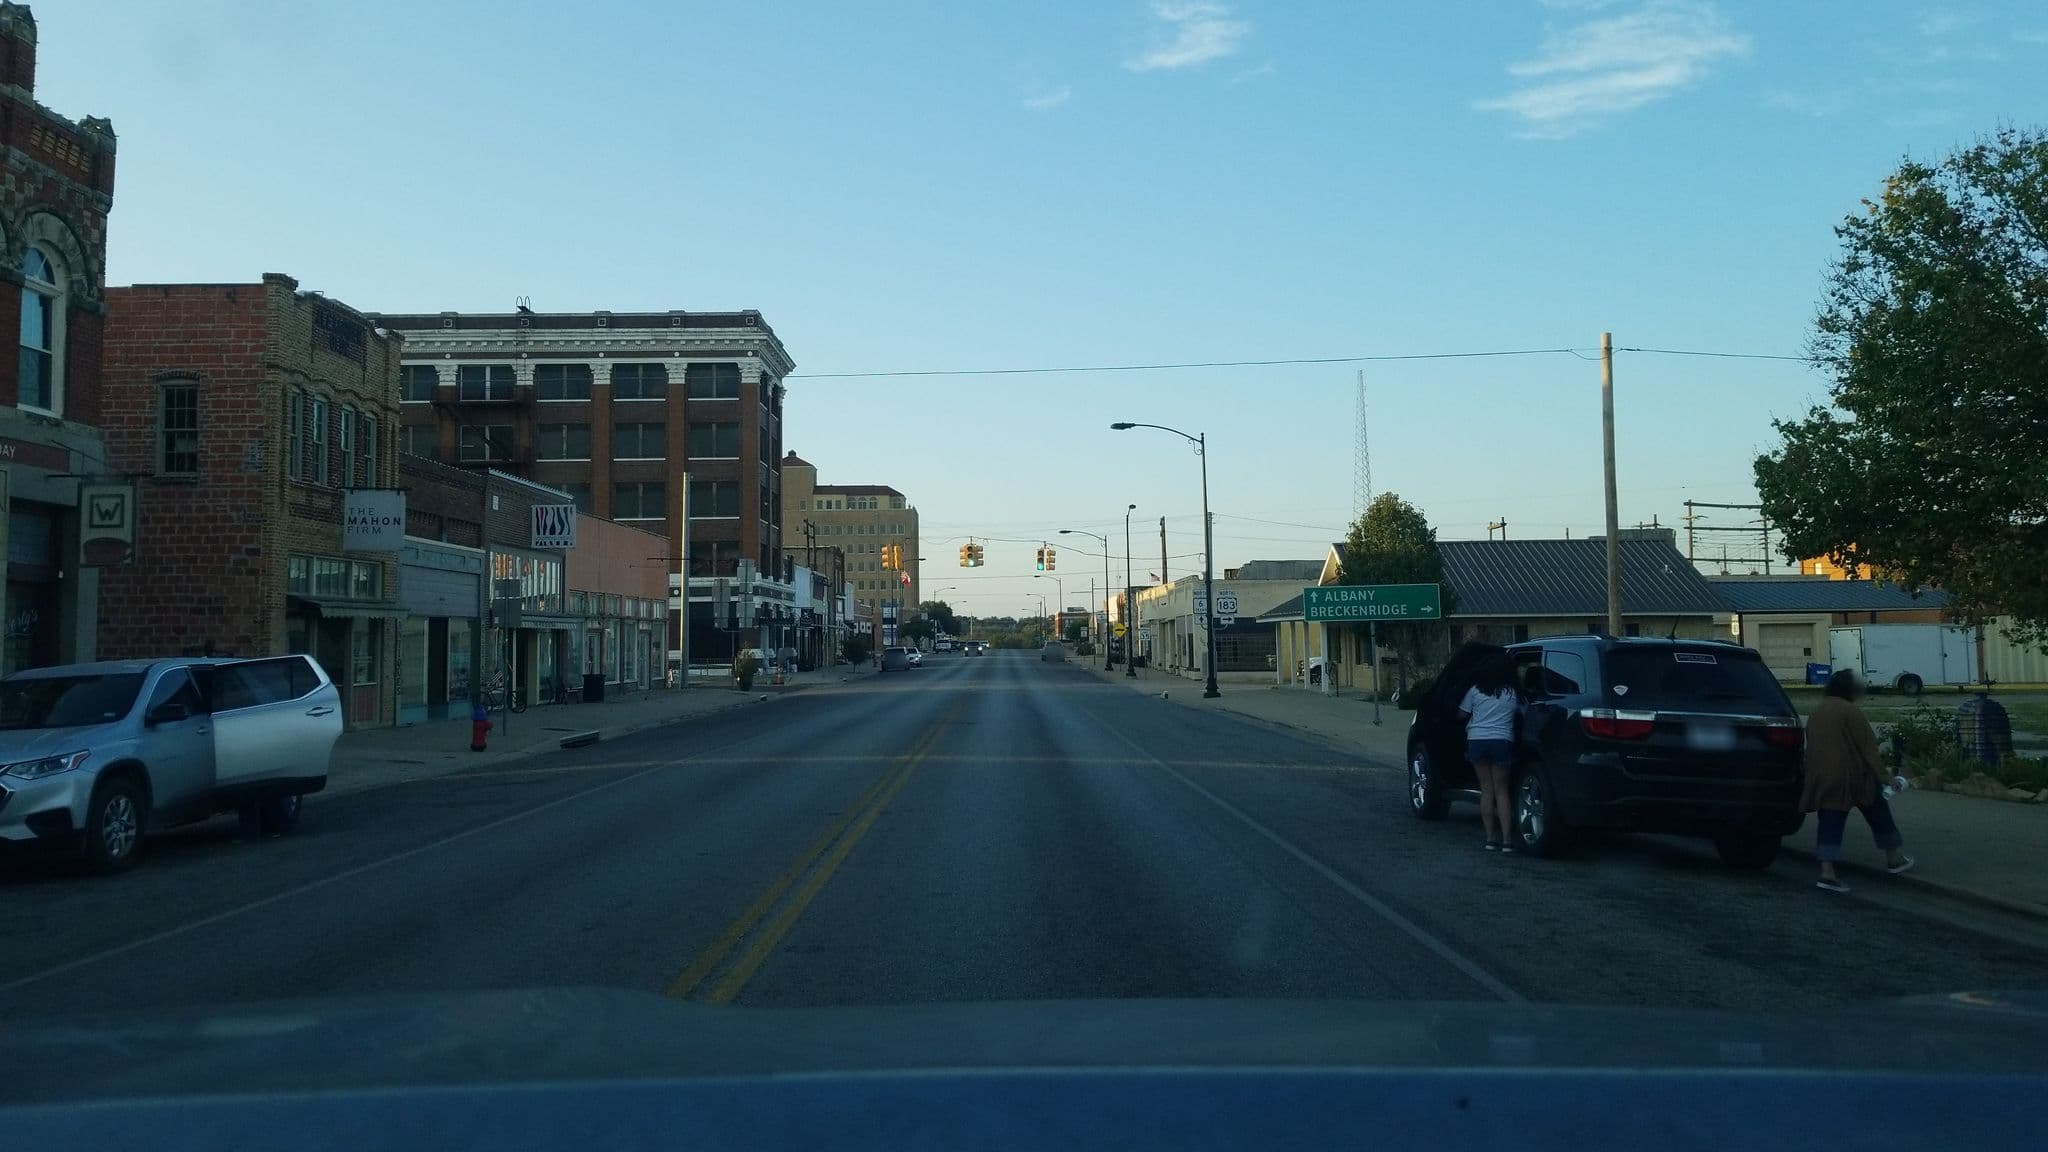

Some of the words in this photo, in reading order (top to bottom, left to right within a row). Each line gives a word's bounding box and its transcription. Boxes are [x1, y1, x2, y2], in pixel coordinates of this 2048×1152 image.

[0, 444, 16, 457] AY
[95, 502, 120, 521] W
[349, 507, 375, 515] THE
[347, 516, 401, 526] MAHON
[347, 526, 382, 535] FIRM
[1324, 590, 1376, 602] ALBANY
[1198, 600, 1204, 608] 6
[1219, 601, 1236, 610] 183
[1310, 604, 1408, 617] BRECKENRIDGE
